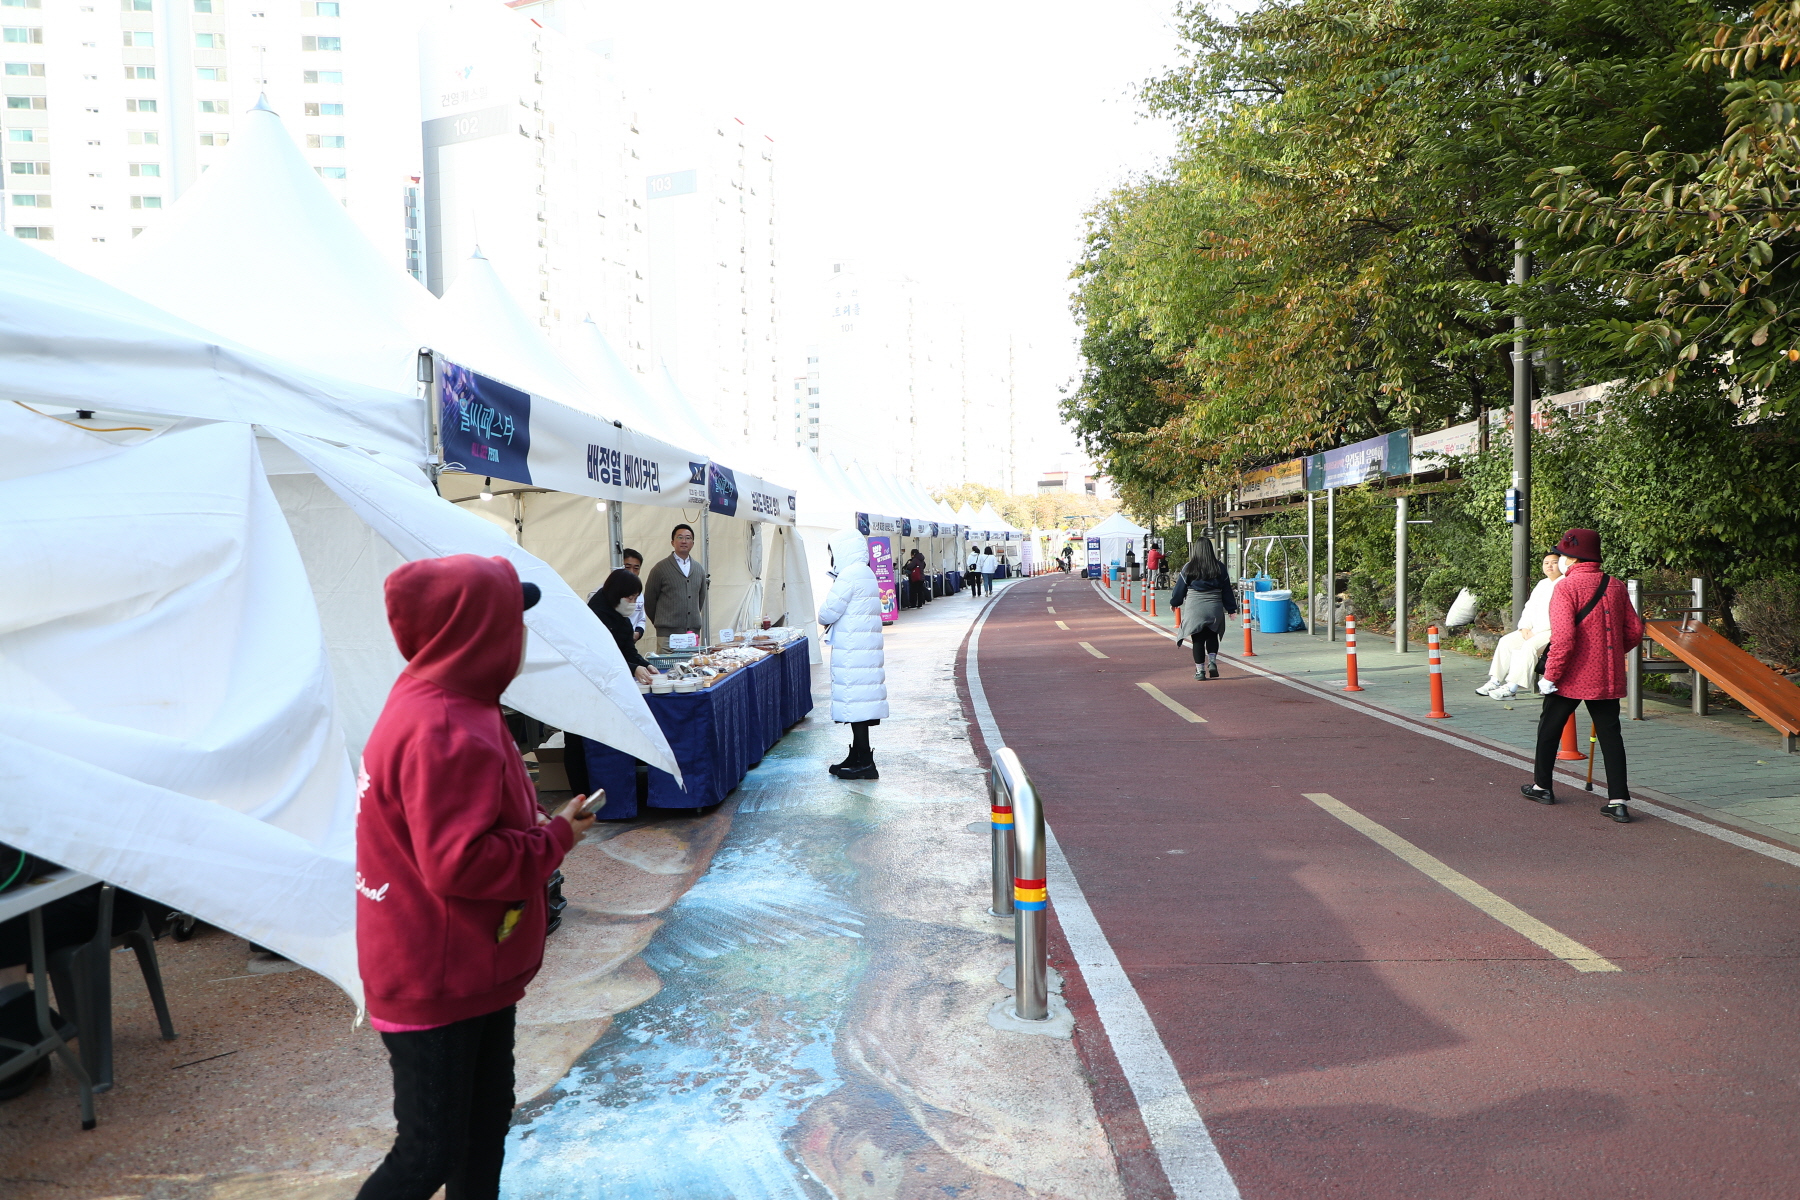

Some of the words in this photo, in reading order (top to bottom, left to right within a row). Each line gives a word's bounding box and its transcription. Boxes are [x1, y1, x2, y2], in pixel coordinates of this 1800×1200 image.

[453, 116, 479, 136] 102
[650, 176, 672, 192] 103
[587, 443, 622, 486] 배정열
[624, 454, 661, 493] 베이커리
